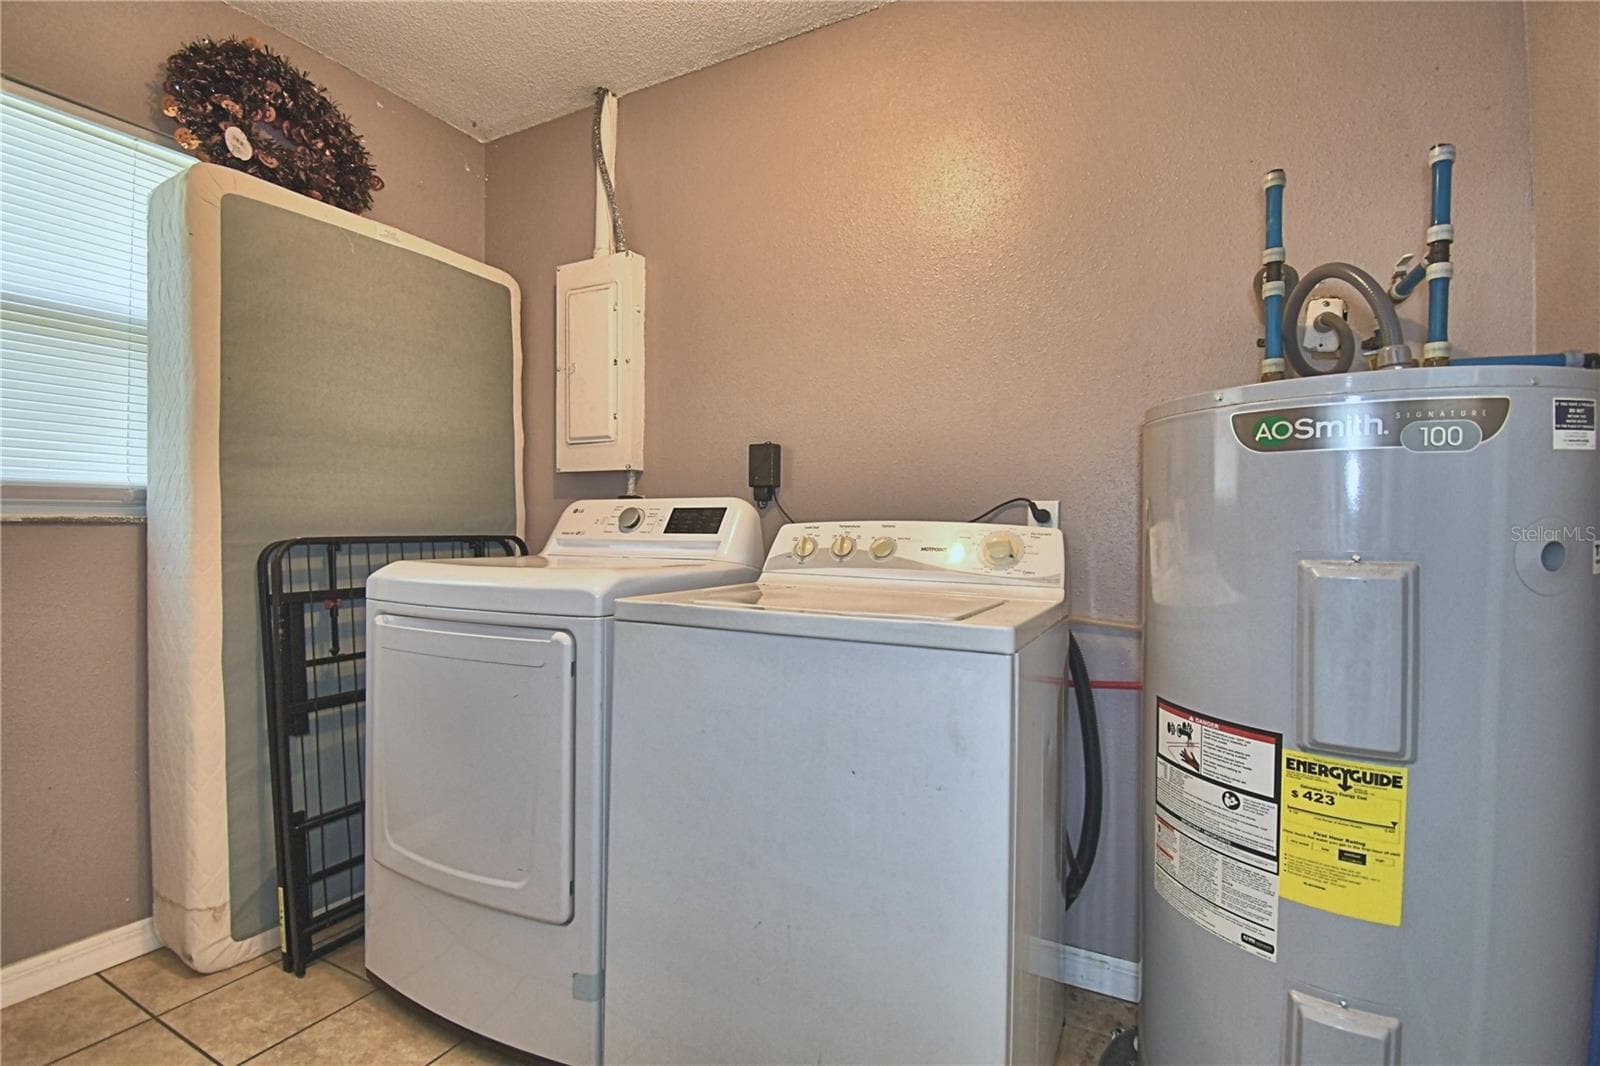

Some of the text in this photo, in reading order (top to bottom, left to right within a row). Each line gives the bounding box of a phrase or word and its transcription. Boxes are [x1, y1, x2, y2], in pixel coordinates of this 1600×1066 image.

[1395, 408, 1488, 420] SIGNATURE
[1419, 425, 1464, 447] 100
[1194, 716, 1219, 729] DANGER
[1302, 790, 1336, 806] 423
